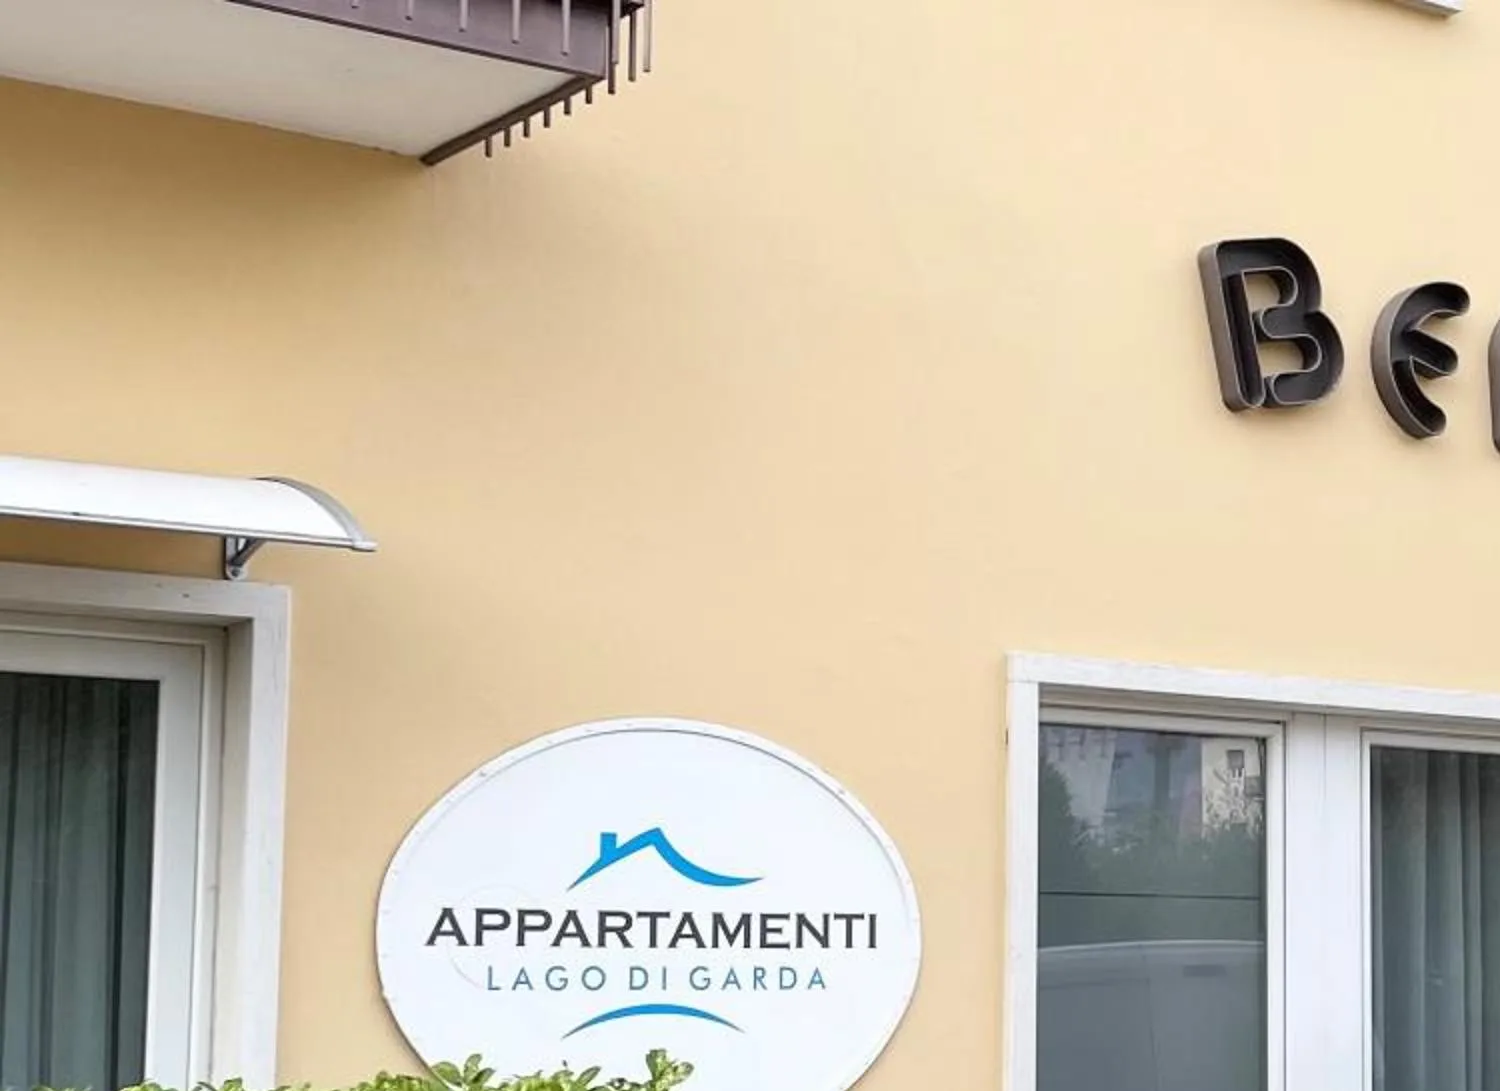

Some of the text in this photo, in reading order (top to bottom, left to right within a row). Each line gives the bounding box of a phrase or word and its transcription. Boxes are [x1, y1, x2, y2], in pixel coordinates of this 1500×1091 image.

[425, 907, 878, 949] APPARTAMENTI
[487, 965, 827, 991] LAGO DI GARDA
